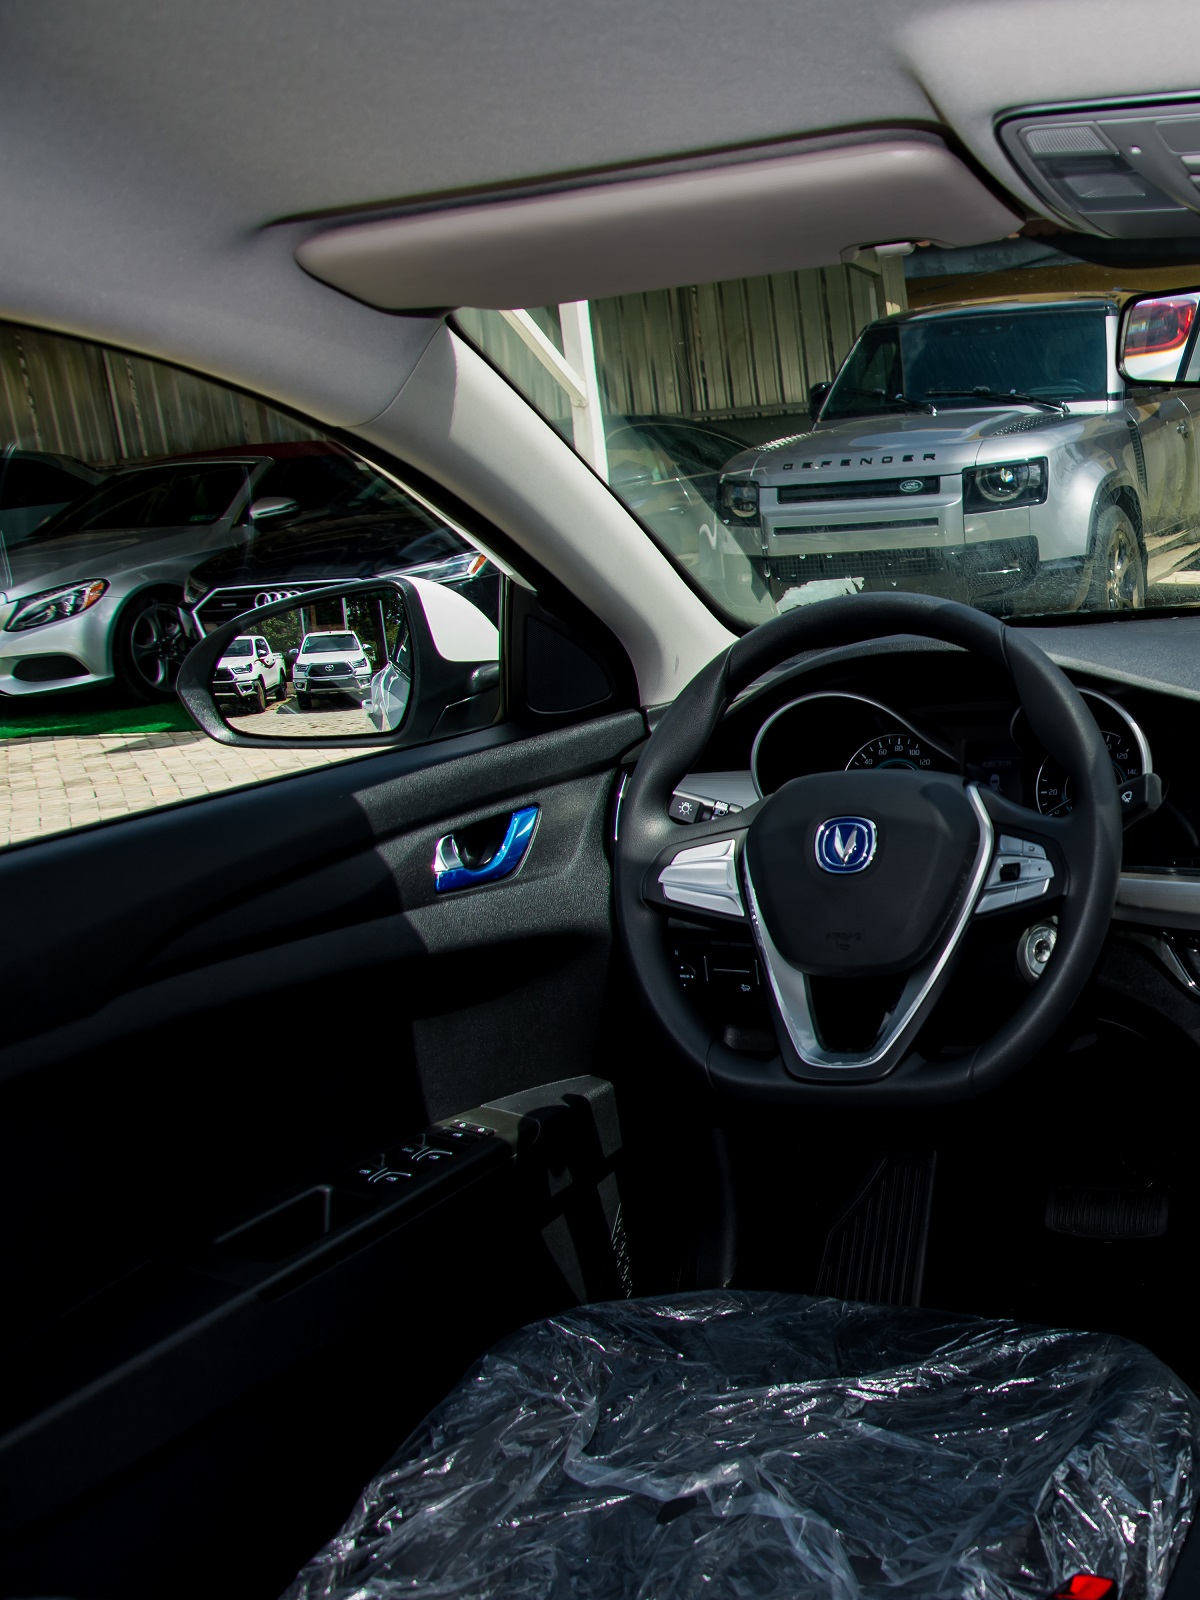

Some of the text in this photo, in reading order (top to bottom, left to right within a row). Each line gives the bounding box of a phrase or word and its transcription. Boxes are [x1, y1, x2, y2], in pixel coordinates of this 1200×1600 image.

[782, 453, 936, 471] DEFENDER
[1116, 752, 1128, 760] 120
[1048, 788, 1058, 796] 20
